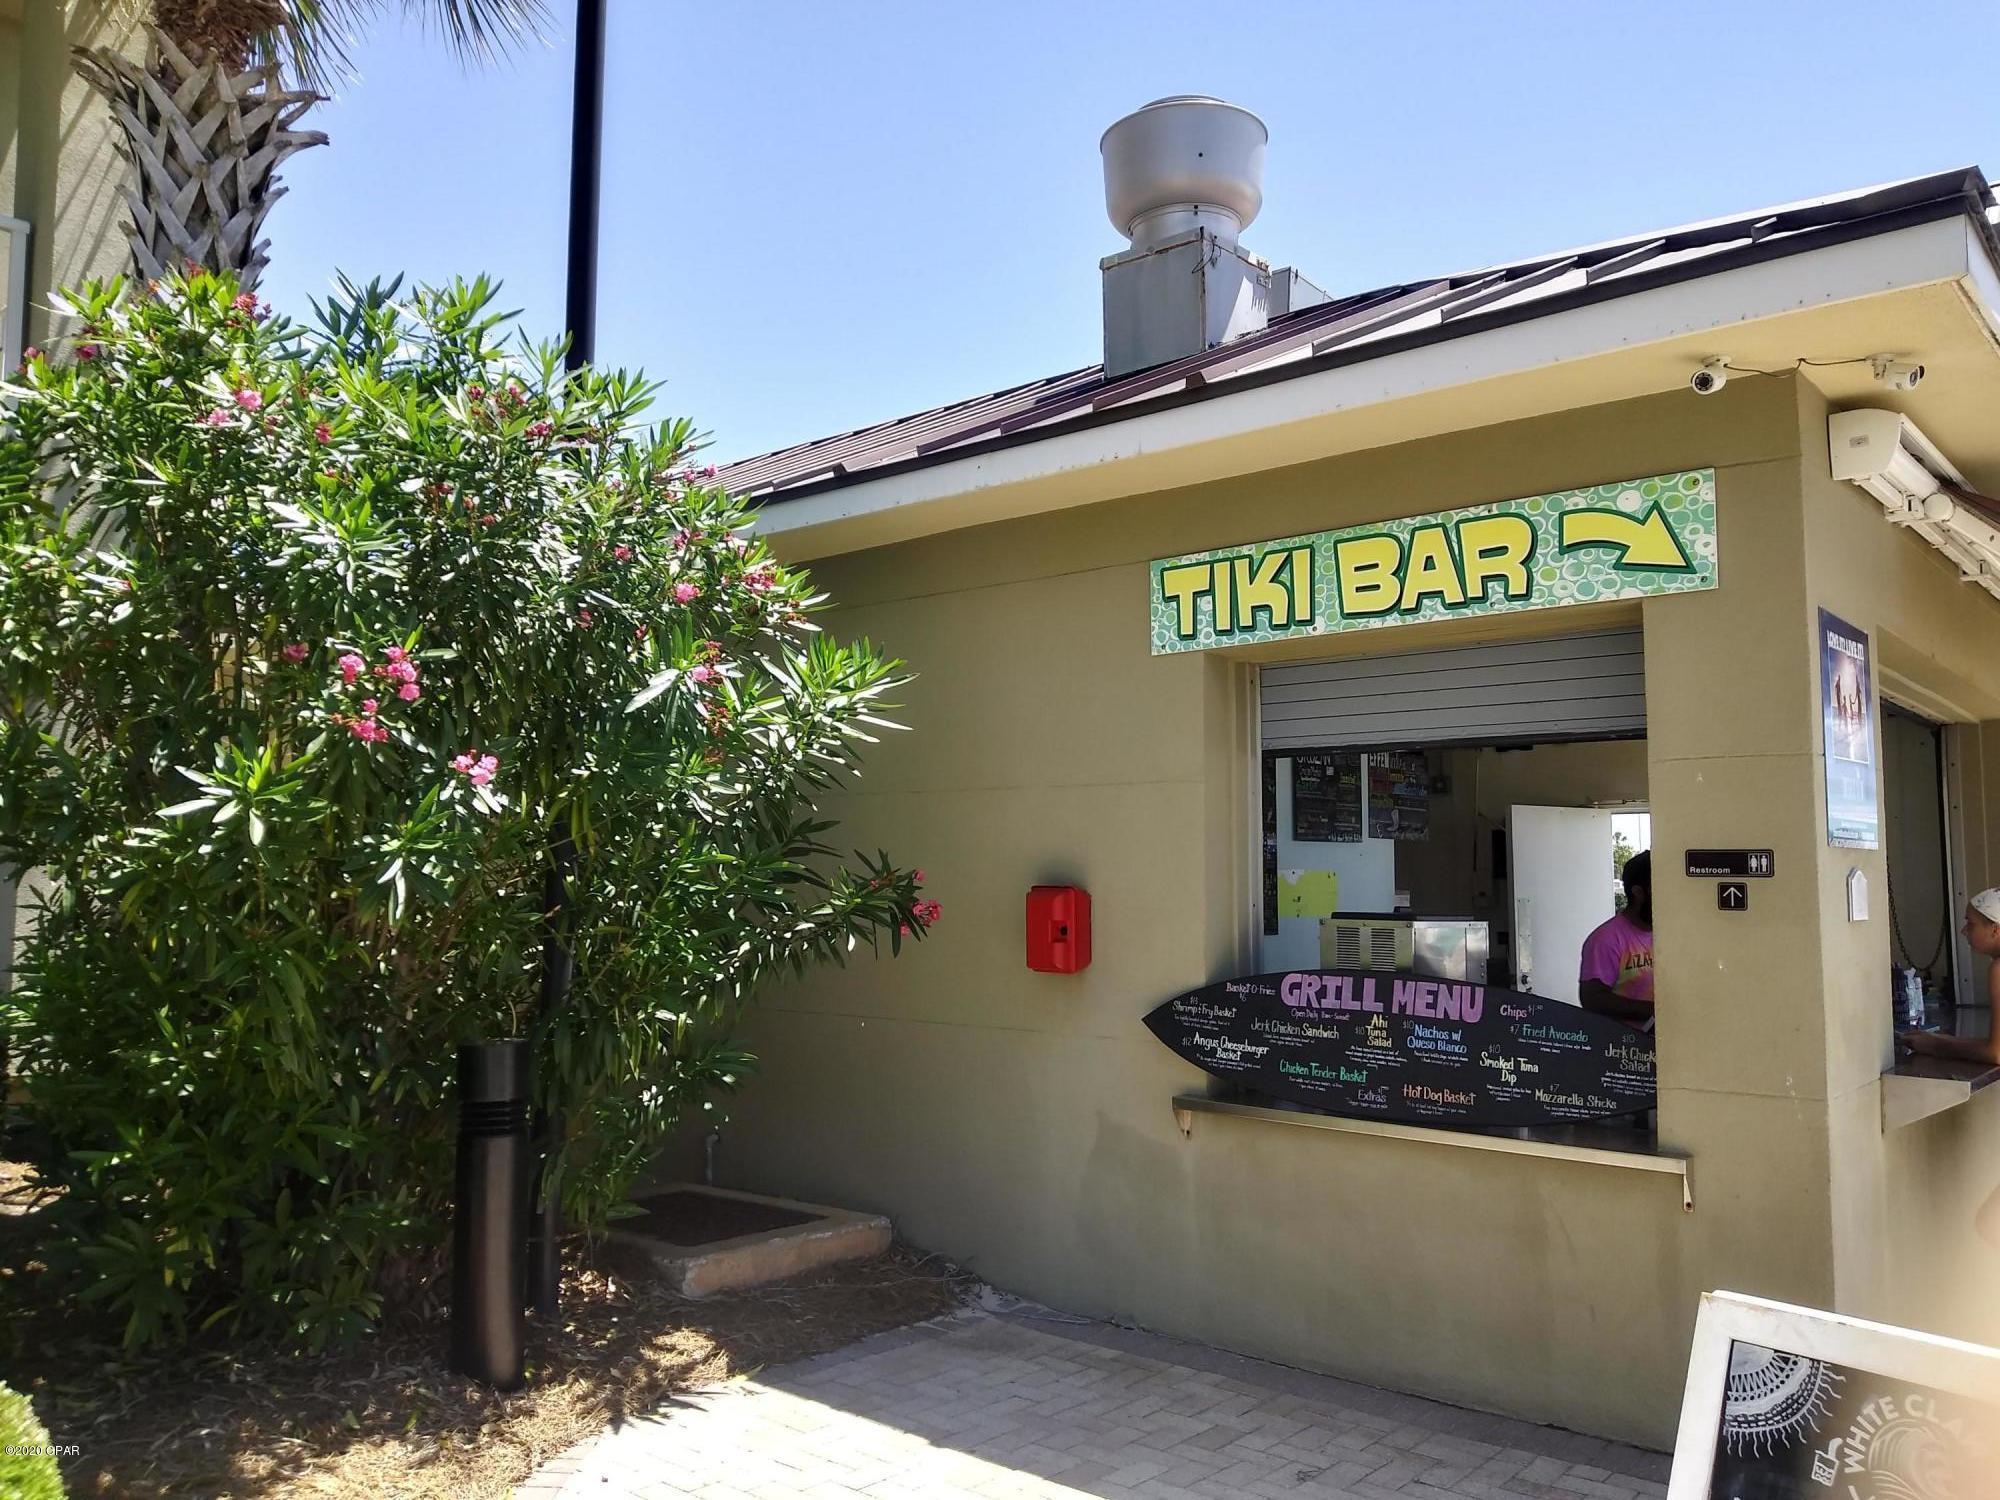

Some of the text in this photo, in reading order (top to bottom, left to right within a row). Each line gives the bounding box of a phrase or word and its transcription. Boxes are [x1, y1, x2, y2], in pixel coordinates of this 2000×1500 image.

[1161, 512, 1537, 641] TIKI BAR
[1689, 866, 1731, 874] Restroom
[1226, 982, 1250, 994] Basket
[1281, 973, 1485, 1023] GRILL MENU
[1172, 1000, 1197, 1016] Shrimp
[1202, 1003, 1213, 1019] Fry
[1213, 1005, 1238, 1018] Basket
[1291, 1008, 1305, 1020] Open
[1500, 1004, 1527, 1021] Chips
[1250, 1017, 1271, 1033] Jerk
[1271, 1020, 1301, 1035] Chicken
[1301, 1023, 1340, 1040] Sandwich
[1370, 1013, 1389, 1028] Ahi
[1402, 1020, 1414, 1030] $10
[1365, 1025, 1387, 1038] Tuna
[1414, 1024, 1462, 1042] Nachos w/
[1509, 1024, 1589, 1043] $7 Fried Avocado
[1621, 1034, 1636, 1043] $10
[1182, 1036, 1192, 1047] $12
[1193, 1031, 1219, 1051] Angus
[1220, 1035, 1270, 1059] Cheeseburger
[1366, 1036, 1392, 1048] Salad
[1406, 1036, 1467, 1054] Queso Blanco
[1488, 1043, 1501, 1055] $10
[1216, 1048, 1242, 1061] Basket
[1604, 1042, 1629, 1060] Jerk
[1629, 1046, 1656, 1063] Chick
[1479, 1051, 1514, 1071] Smoked
[1517, 1057, 1539, 1073] Tuna
[1619, 1058, 1651, 1073] Salad
[1279, 1059, 1309, 1076] Chicken
[1310, 1062, 1339, 1080] Tender
[1340, 1066, 1369, 1083] Basket
[1501, 1070, 1517, 1086] Dip
[1357, 1089, 1387, 1103] Extras
[1402, 1084, 1423, 1099] Hot
[1423, 1086, 1443, 1106] Dog
[1443, 1089, 1477, 1106] Basket
[1535, 1088, 1584, 1106] Mozzarella
[1586, 1094, 1617, 1109] Sticks
[1843, 1395, 1900, 1474] WHITE
